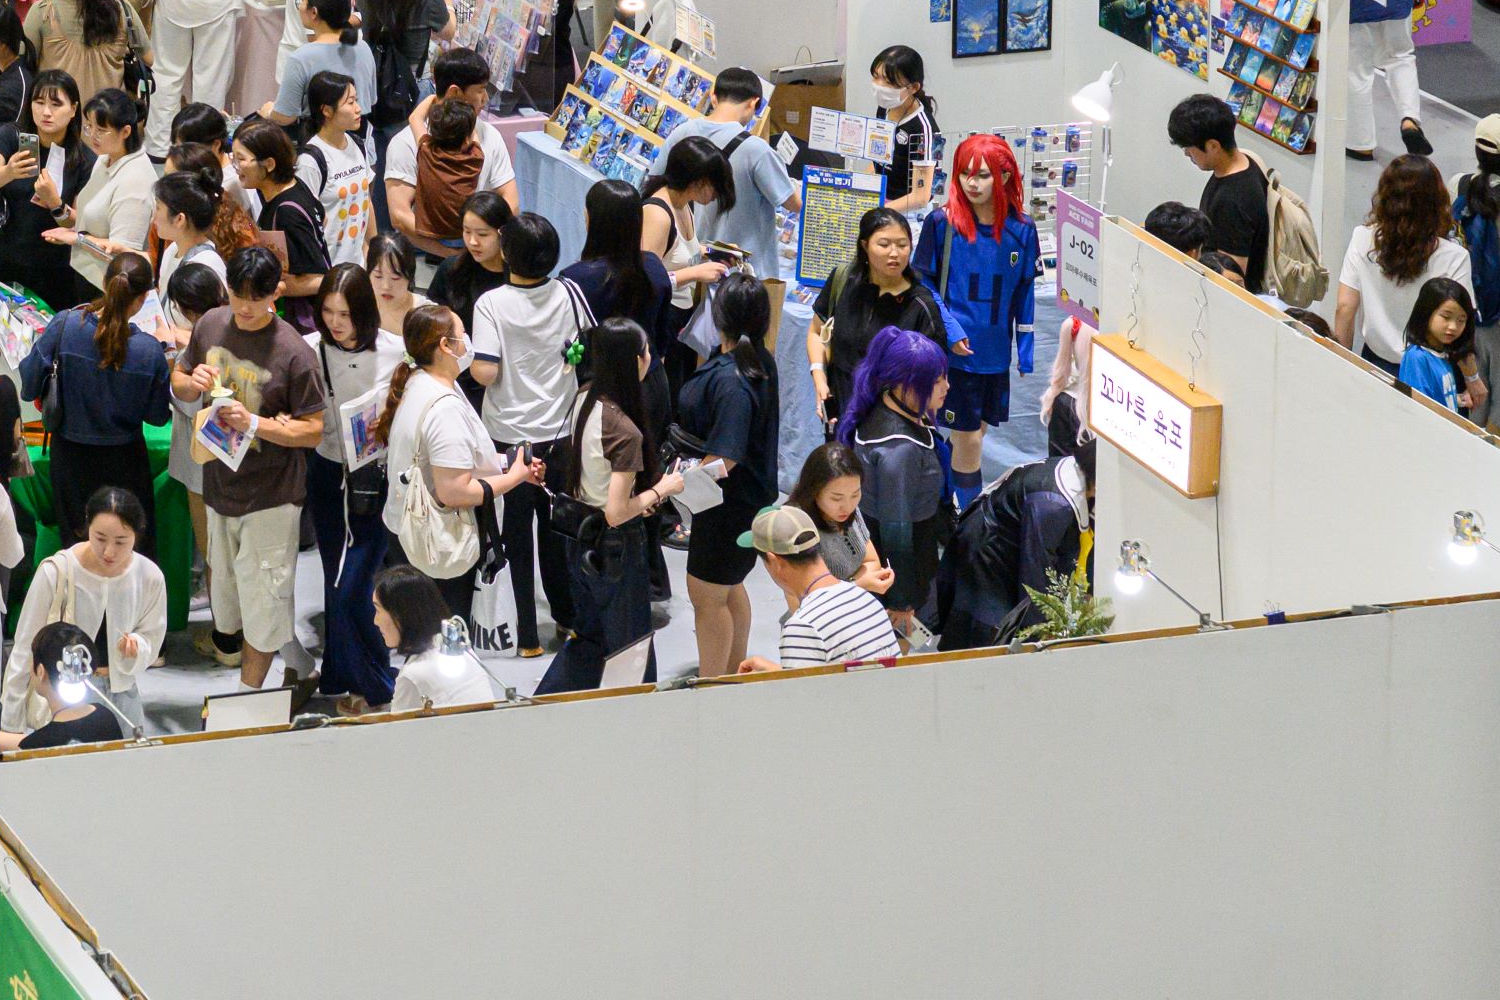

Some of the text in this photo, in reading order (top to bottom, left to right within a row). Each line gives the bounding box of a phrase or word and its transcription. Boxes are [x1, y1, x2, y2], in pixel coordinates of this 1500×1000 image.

[1069, 234, 1094, 260] J-02
[1101, 373, 1147, 426] 꼬마루
[1154, 410, 1182, 450] 육포
